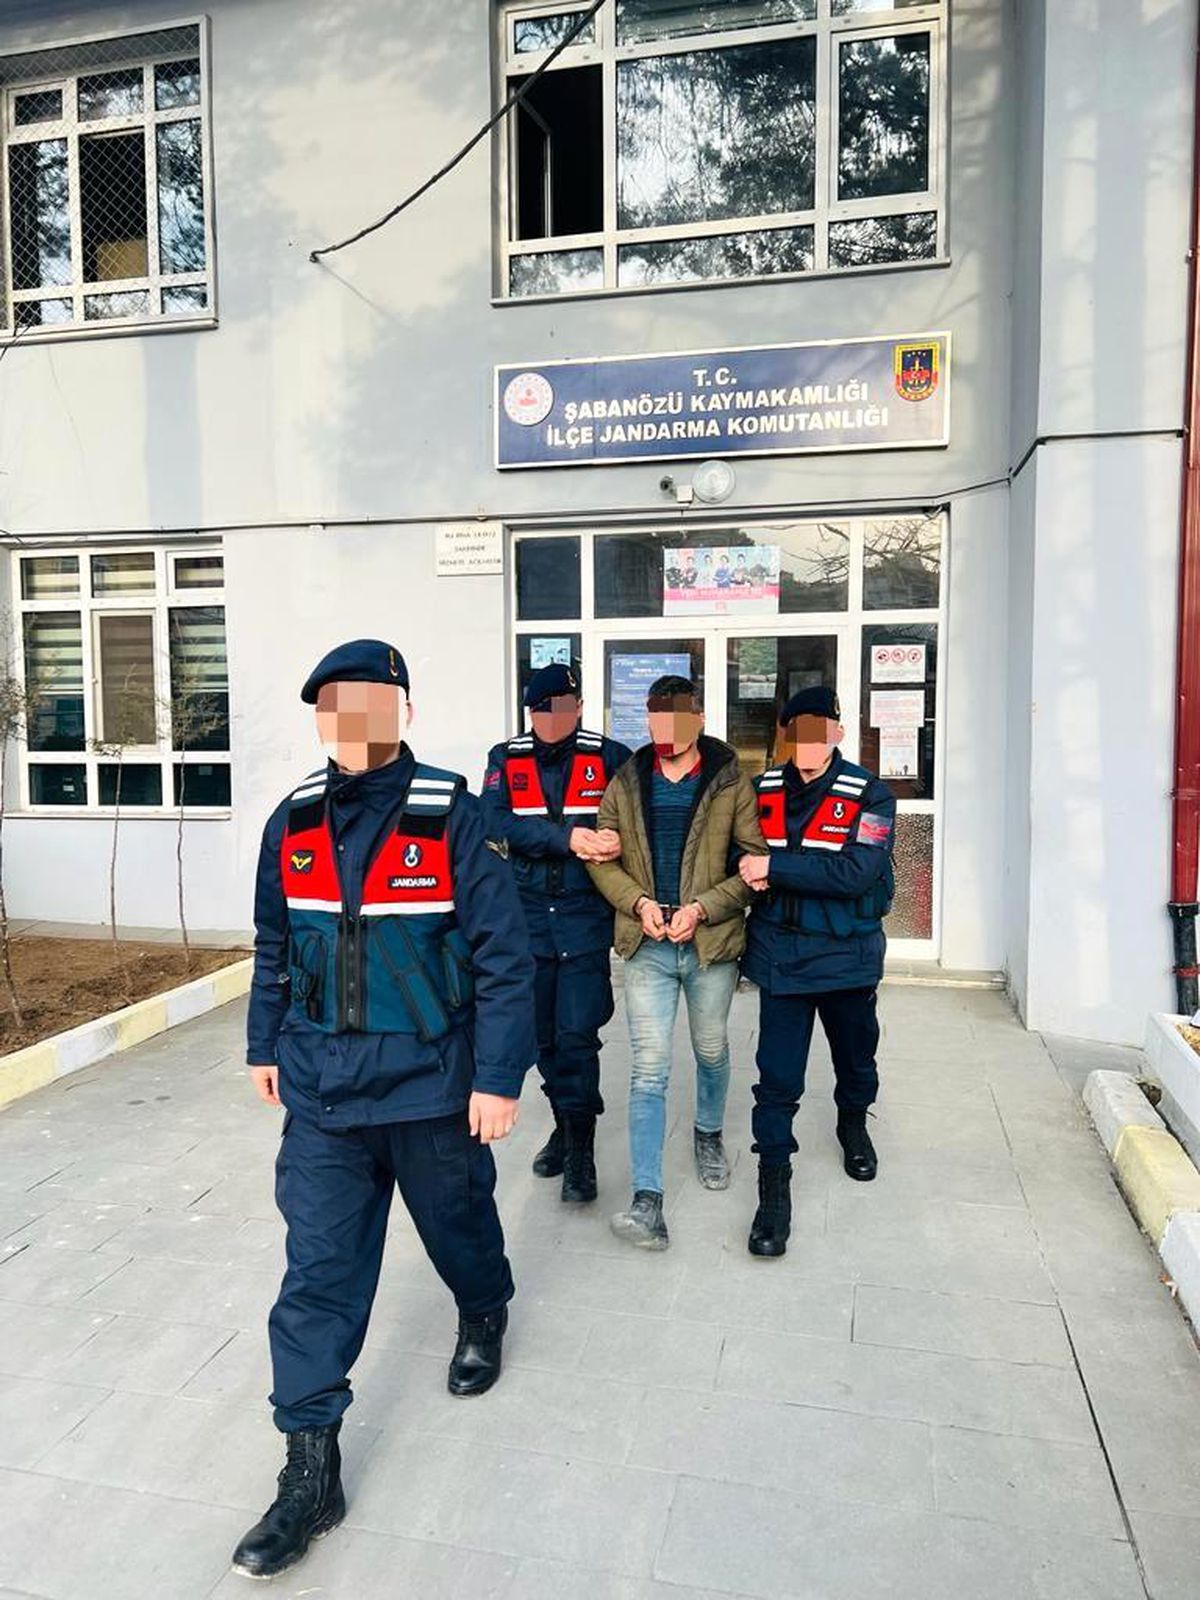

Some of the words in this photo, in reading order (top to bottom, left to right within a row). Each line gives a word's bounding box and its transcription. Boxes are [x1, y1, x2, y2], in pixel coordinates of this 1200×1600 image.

[564, 391, 684, 424] ŞABANÖZÜ
[690, 379, 869, 412] KAYMAKAMLIĞI
[546, 424, 594, 449] İLÇE
[600, 419, 721, 444] JANDARMA
[727, 404, 889, 436] KOMUTANLIĞI
[391, 877, 437, 887] JANDARMA
